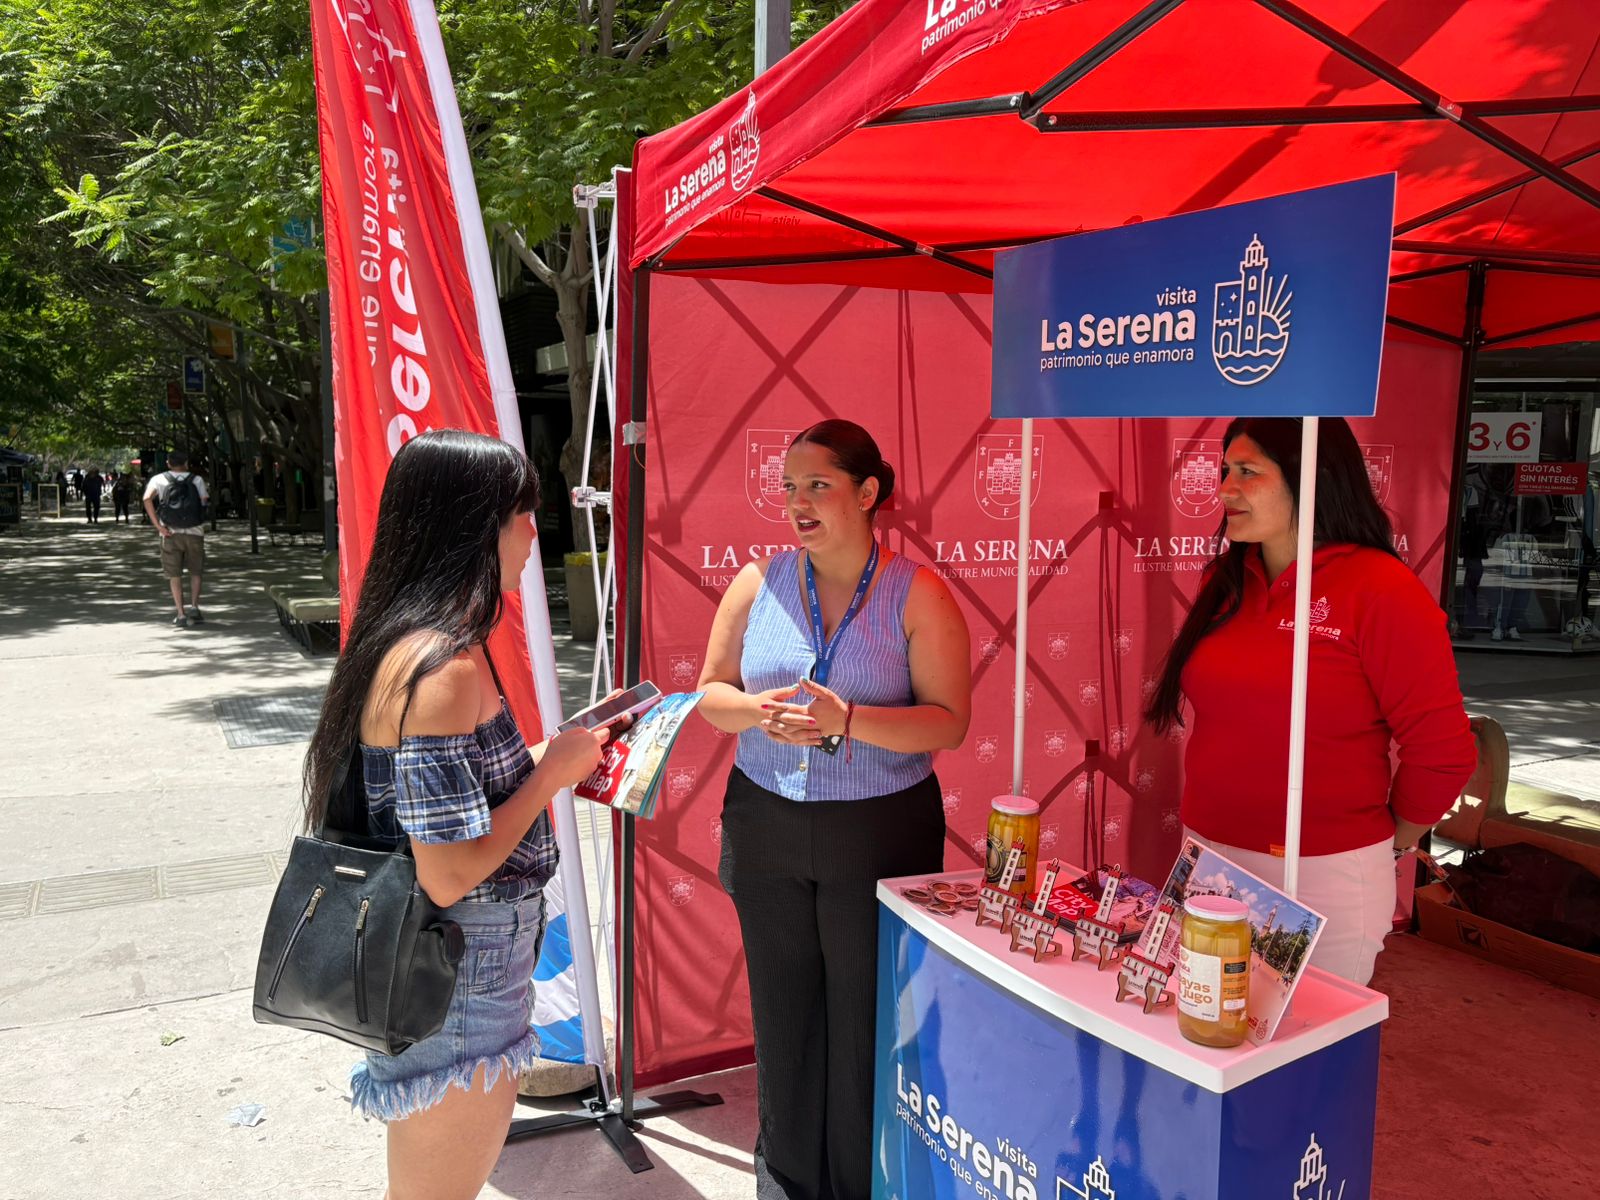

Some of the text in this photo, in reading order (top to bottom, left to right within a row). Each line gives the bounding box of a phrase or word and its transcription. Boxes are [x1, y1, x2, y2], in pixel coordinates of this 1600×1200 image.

[921, 0, 987, 55] patrimonio
[709, 135, 724, 154] visita
[665, 149, 726, 214] La Serena
[1156, 285, 1197, 306] visita
[1041, 309, 1196, 351] La Serena
[1040, 348, 1195, 372] patrimonio que enamora
[1468, 422, 1490, 451] 3
[1520, 474, 1579, 484] SIN INTERÉS
[1521, 464, 1562, 473] CUOTAS
[701, 546, 740, 568] LA
[935, 539, 1069, 562] LA SERNA
[1135, 536, 1231, 557] LA SEREN
[981, 565, 1069, 577] MUNICALIDAD
[1134, 562, 1172, 572] ILUSTRE
[1308, 625, 1342, 636] rena
[1054, 889, 1093, 908] City
[1180, 976, 1211, 996] ayas
[1183, 988, 1213, 1004] jugo
[896, 1062, 1037, 1200] La Serena
[896, 1101, 972, 1185] patrimonio que
[996, 1136, 1037, 1178] visita
